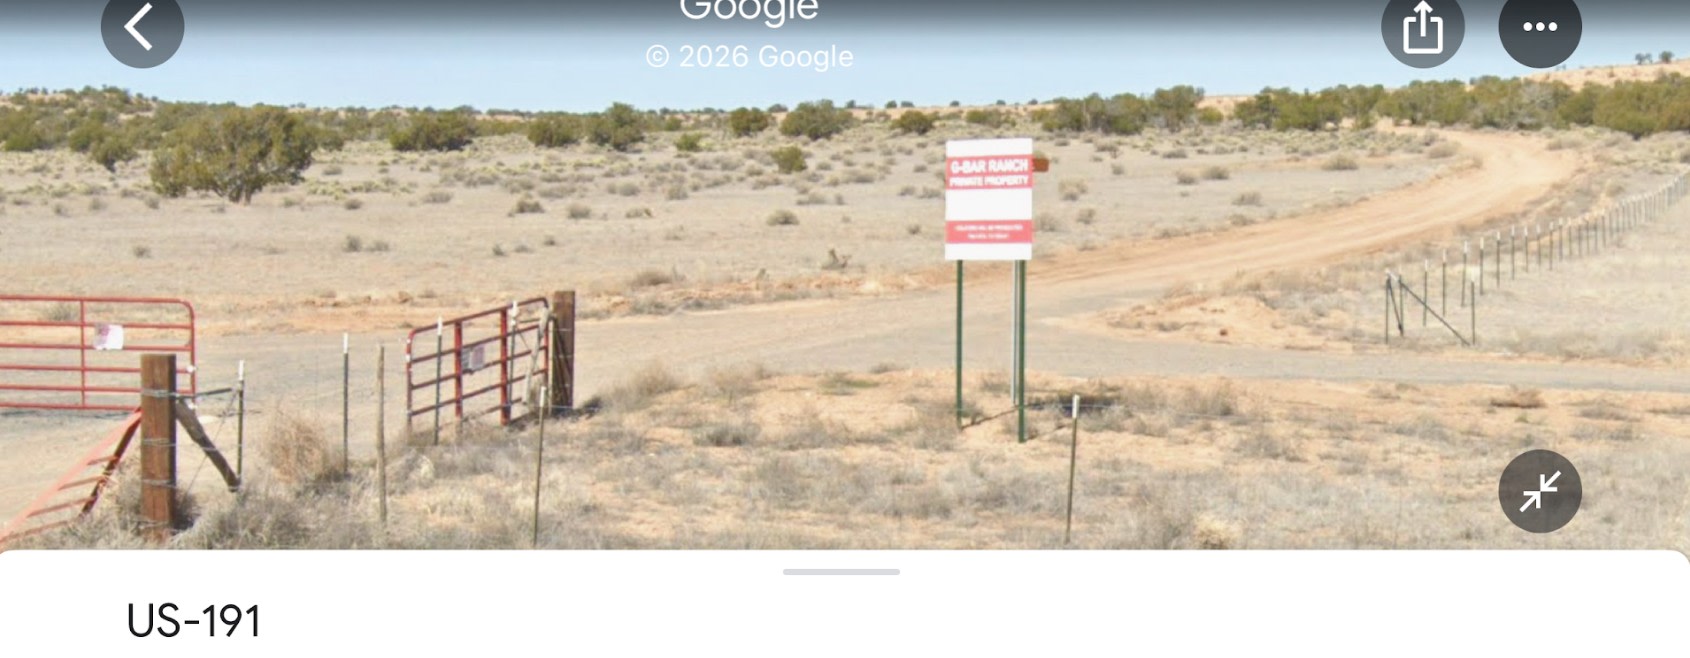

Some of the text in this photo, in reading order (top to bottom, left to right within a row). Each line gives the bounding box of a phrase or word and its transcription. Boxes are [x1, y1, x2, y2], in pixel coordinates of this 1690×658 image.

[988, 158, 1029, 173] RANCH
[949, 174, 1029, 187] PRIVATE PROPERTY
